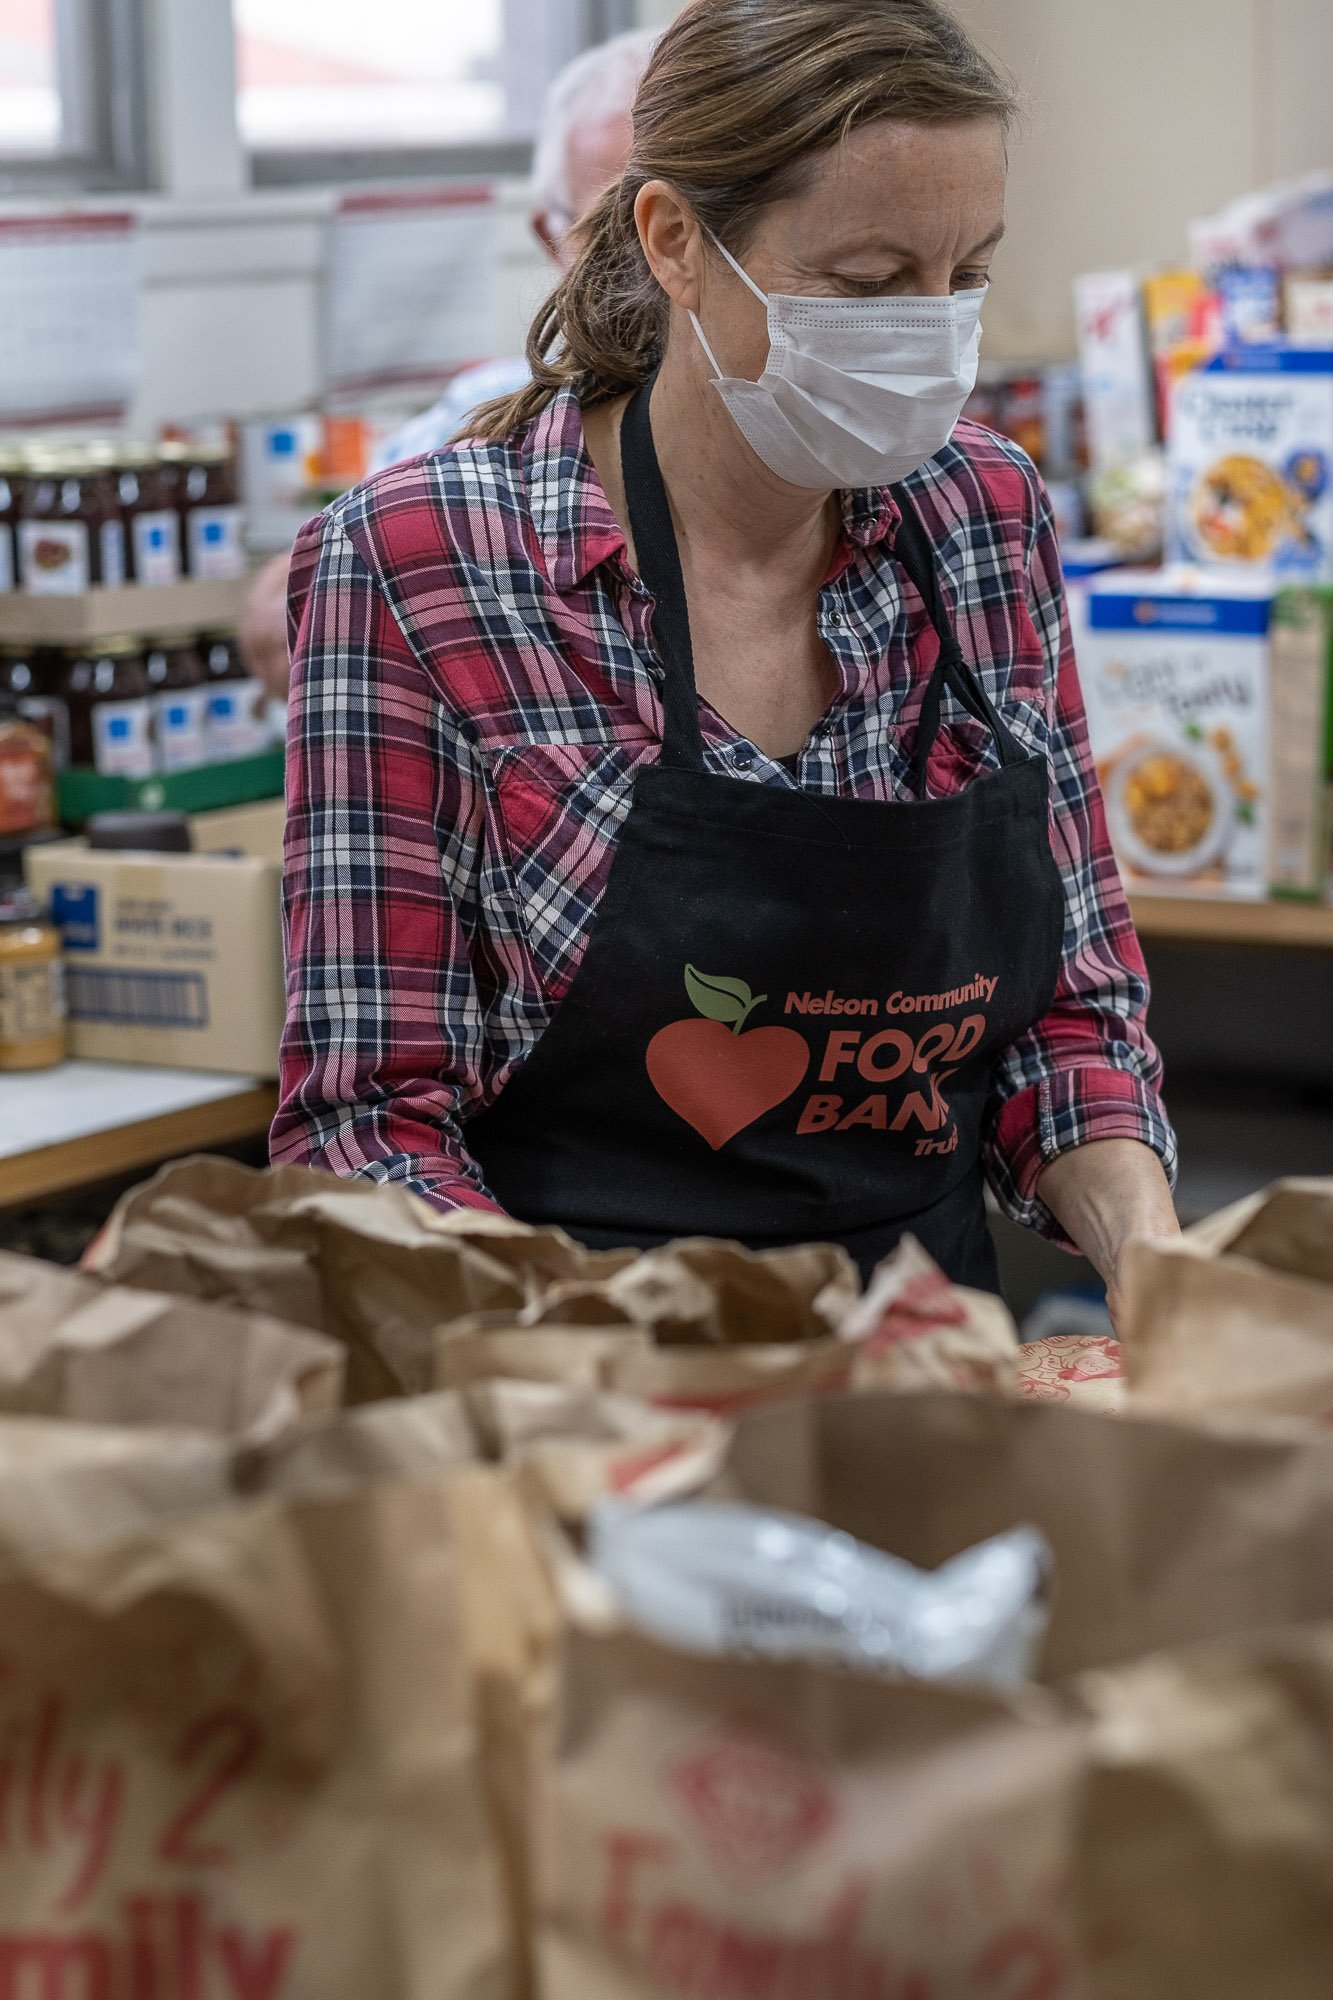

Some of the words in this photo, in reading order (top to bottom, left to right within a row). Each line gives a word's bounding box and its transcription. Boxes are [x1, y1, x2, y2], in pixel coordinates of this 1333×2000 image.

[784, 991, 878, 1016] Nelson
[886, 972, 999, 1015] Community
[818, 1013, 987, 1083] FOOD
[796, 1067, 960, 1135] BANK
[913, 1122, 960, 1156] Trut
[155, 1704, 264, 1868] 2
